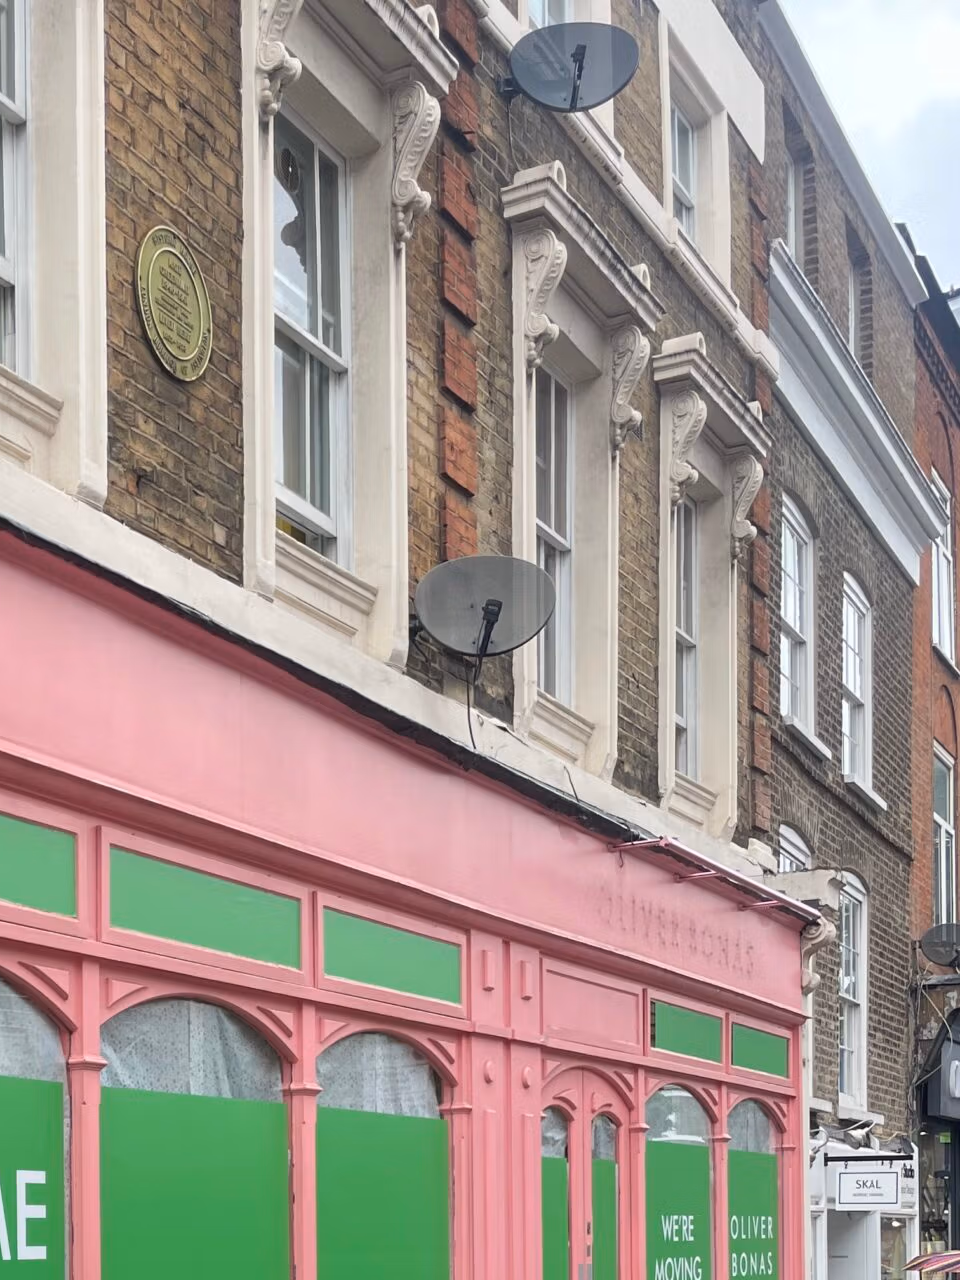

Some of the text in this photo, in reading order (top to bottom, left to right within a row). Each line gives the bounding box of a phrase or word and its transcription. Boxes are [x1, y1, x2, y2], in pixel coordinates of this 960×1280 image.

[661, 1214, 695, 1242] WE'RE
[730, 1215, 774, 1240] OLIVER
[731, 1251, 773, 1277] BONAS
